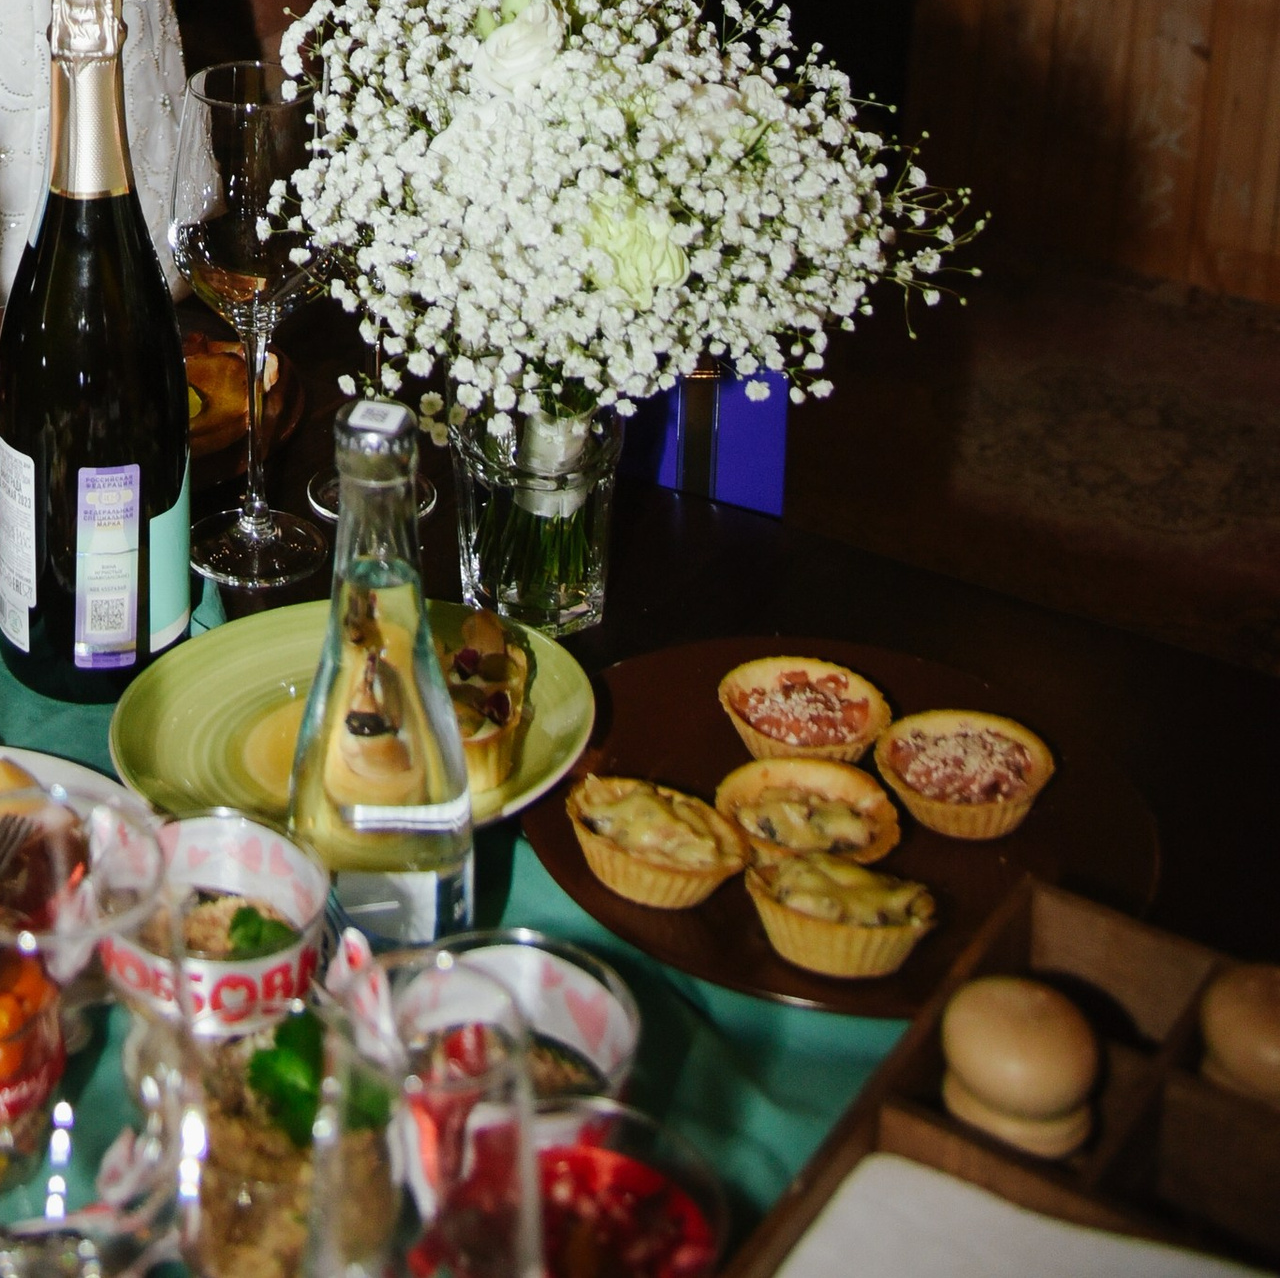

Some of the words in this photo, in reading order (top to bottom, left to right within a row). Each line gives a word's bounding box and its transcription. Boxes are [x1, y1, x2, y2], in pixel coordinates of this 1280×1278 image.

[85, 474, 133, 483] РОССИЙСКАЯ
[86, 480, 133, 489] ФЕДЕРАЦИЯ
[18, 492, 32, 509] 2023
[83, 506, 134, 516] ФЕДЕРАЛЬНАЯ
[83, 513, 134, 522] СПЕЦИАЛЬНАЯ
